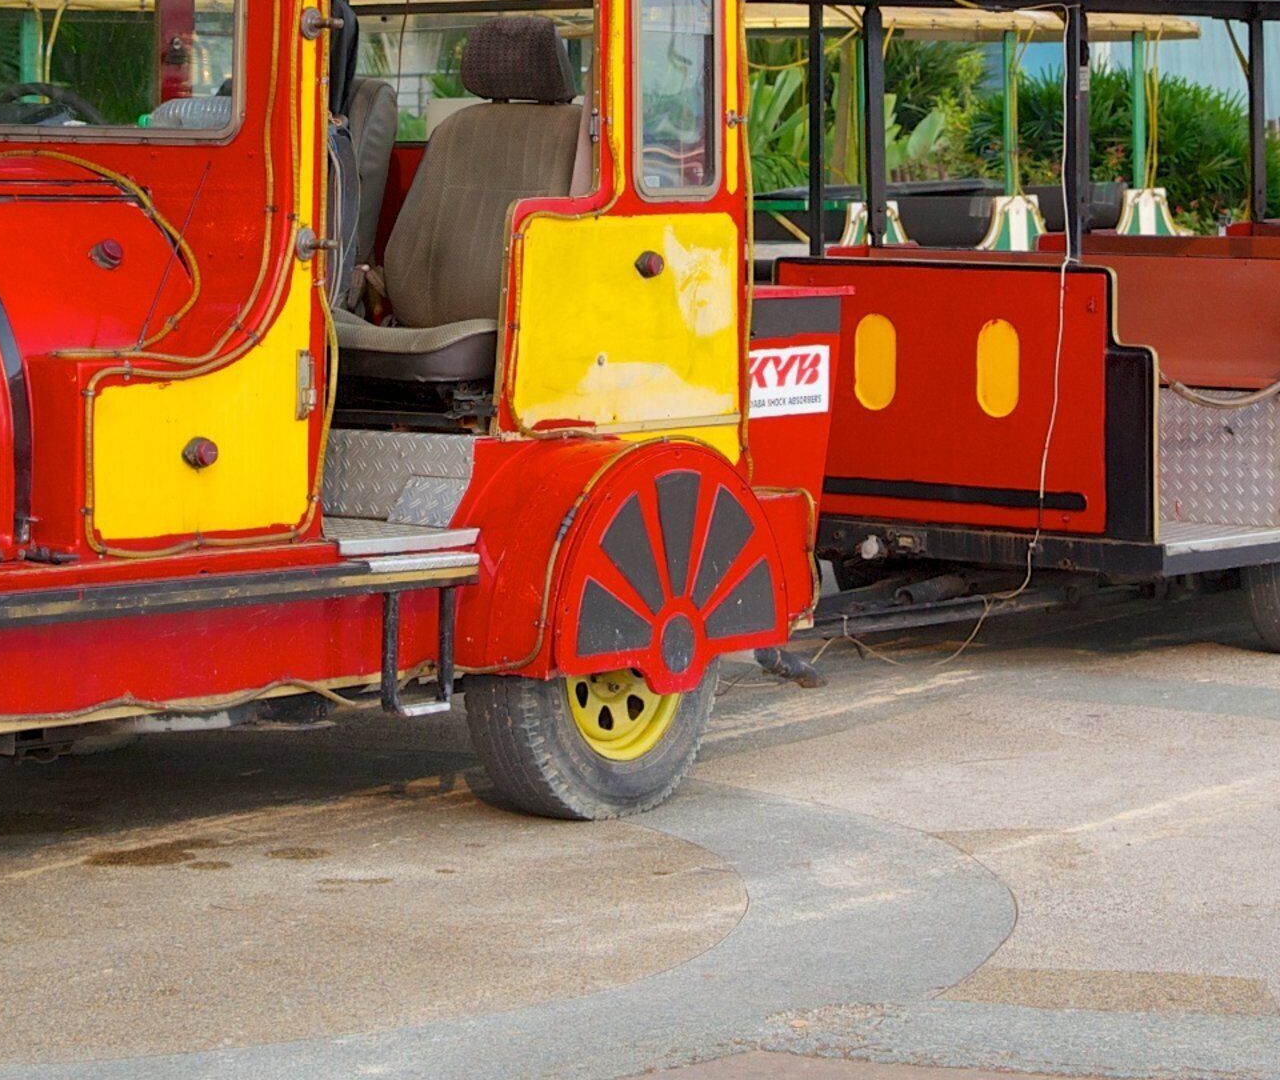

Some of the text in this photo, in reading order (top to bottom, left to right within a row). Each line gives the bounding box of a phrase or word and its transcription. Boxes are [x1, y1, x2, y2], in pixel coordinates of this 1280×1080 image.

[748, 352, 822, 389] KYB
[767, 397, 786, 407] SHOCK
[788, 394, 822, 405] ABSORBERS
